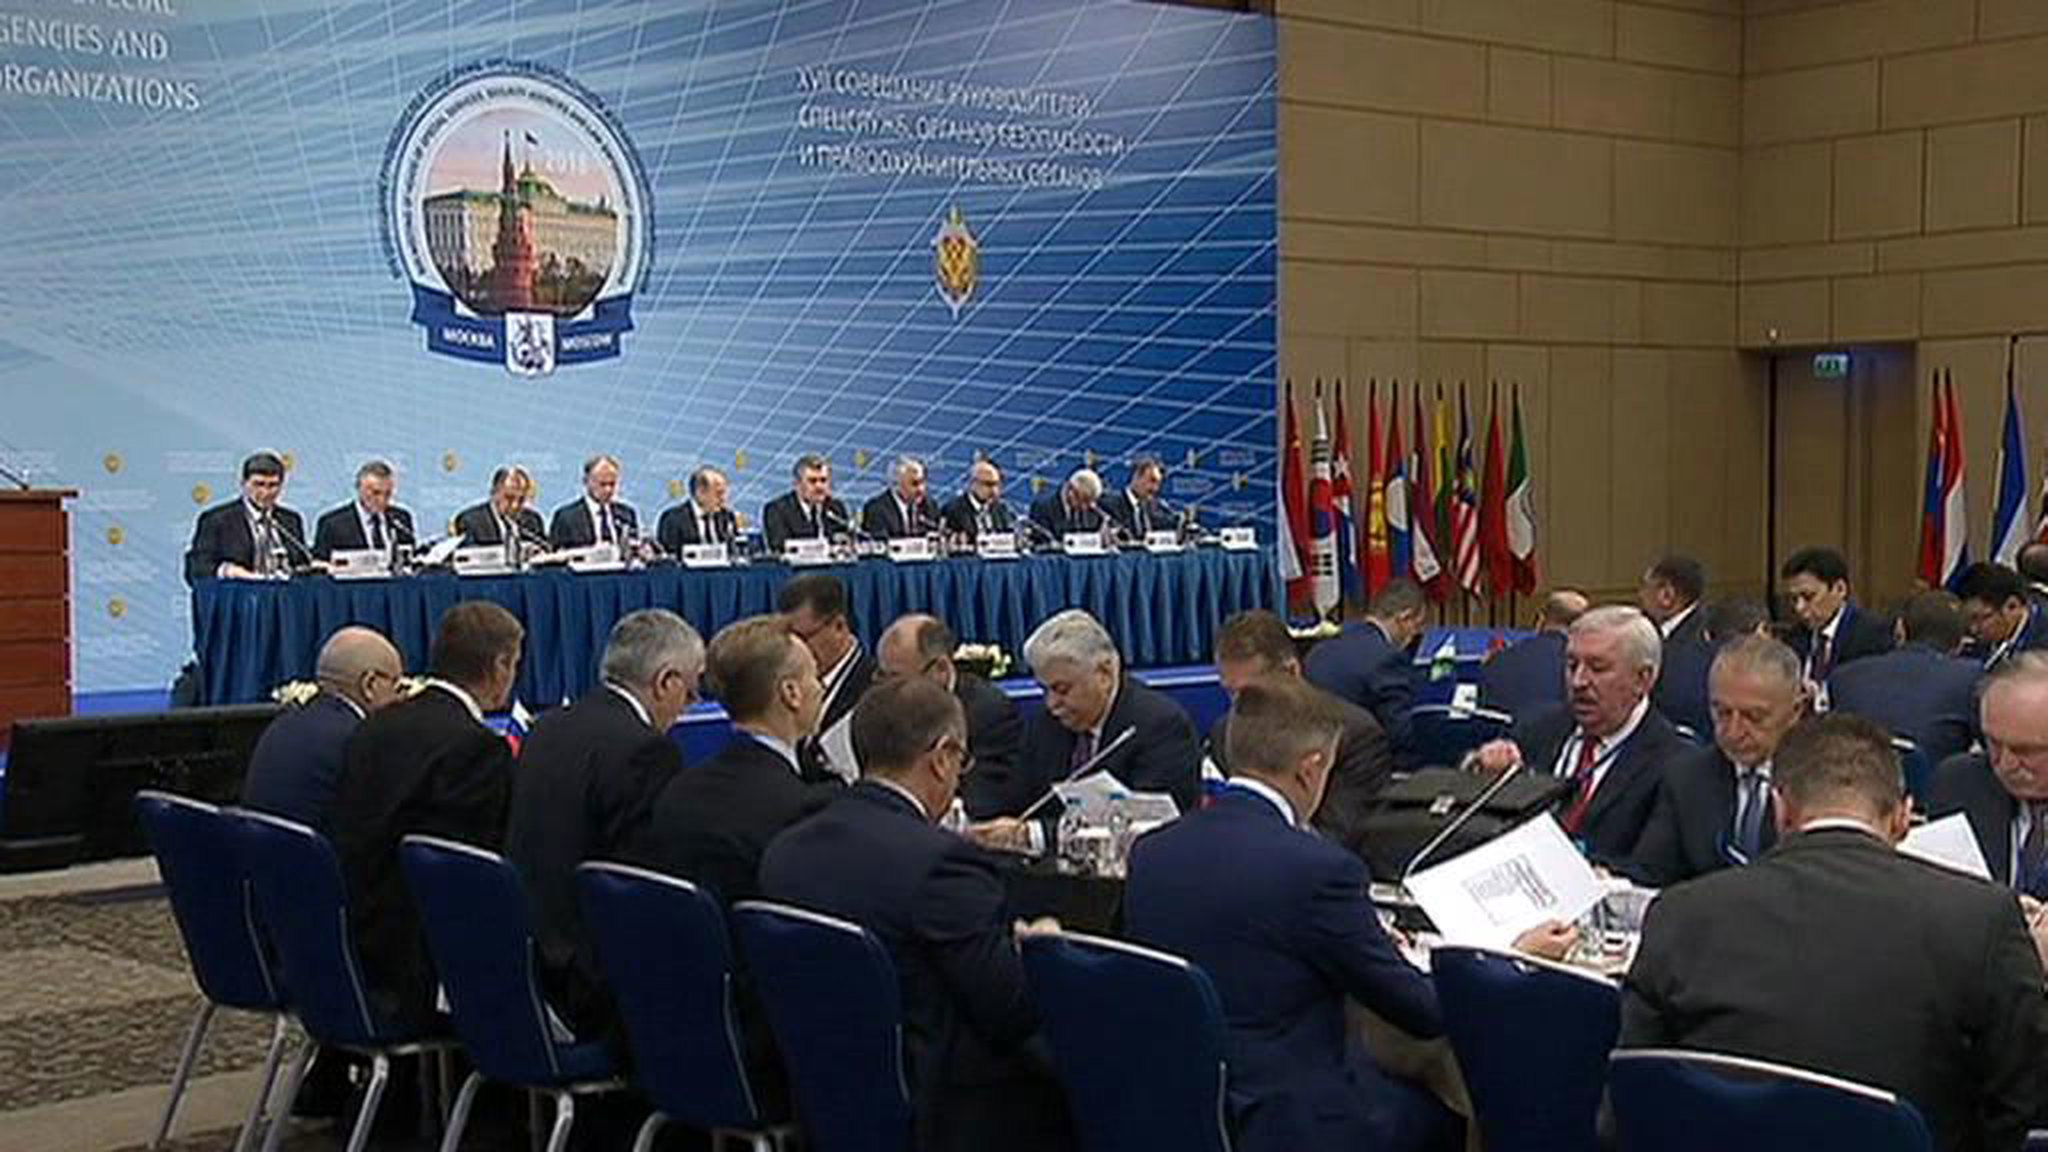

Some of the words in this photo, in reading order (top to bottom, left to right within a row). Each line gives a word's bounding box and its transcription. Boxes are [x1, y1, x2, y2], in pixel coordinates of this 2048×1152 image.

[110, 29, 169, 60] AND
[0, 62, 200, 111] RGANIZATIONS
[443, 326, 497, 350] МОСКВА
